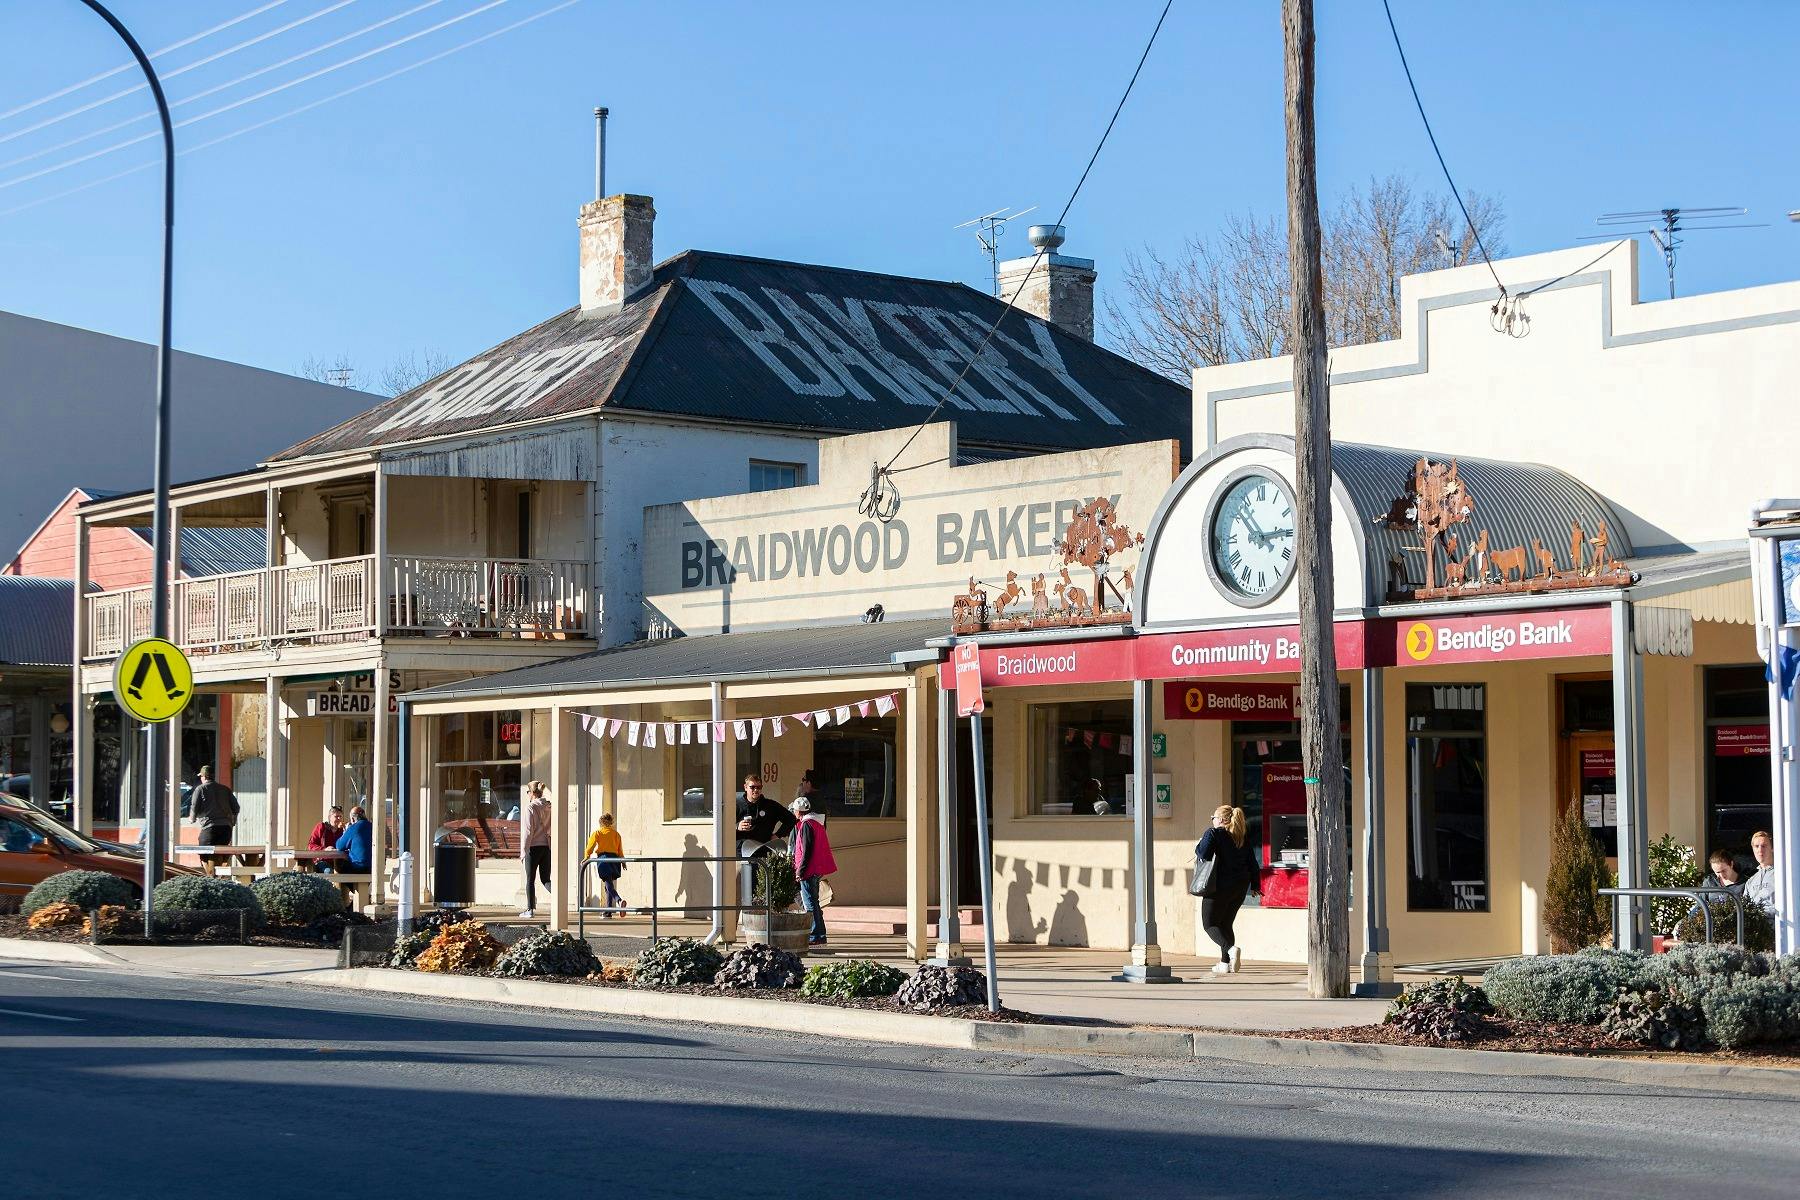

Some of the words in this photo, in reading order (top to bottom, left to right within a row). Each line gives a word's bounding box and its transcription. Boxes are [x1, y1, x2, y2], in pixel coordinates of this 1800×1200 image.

[679, 276, 1125, 426] BAKERY
[1256, 485, 1266, 501] XII
[682, 519, 909, 589] BRAIDWOOD
[1437, 624, 1516, 652] Bendigo
[1519, 620, 1573, 646] Bank
[962, 650, 971, 660] NO
[1171, 638, 1271, 665] Community
[1276, 637, 1300, 659] Ba
[997, 651, 1076, 675] Braidwood
[355, 671, 401, 688] PIS
[320, 694, 370, 712] BREAD
[1207, 693, 1256, 712] Bendigo
[1257, 694, 1288, 709] Bank
[502, 724, 521, 740] OPE
[763, 762, 779, 783] 99
[1273, 774, 1291, 782] Bendigo
